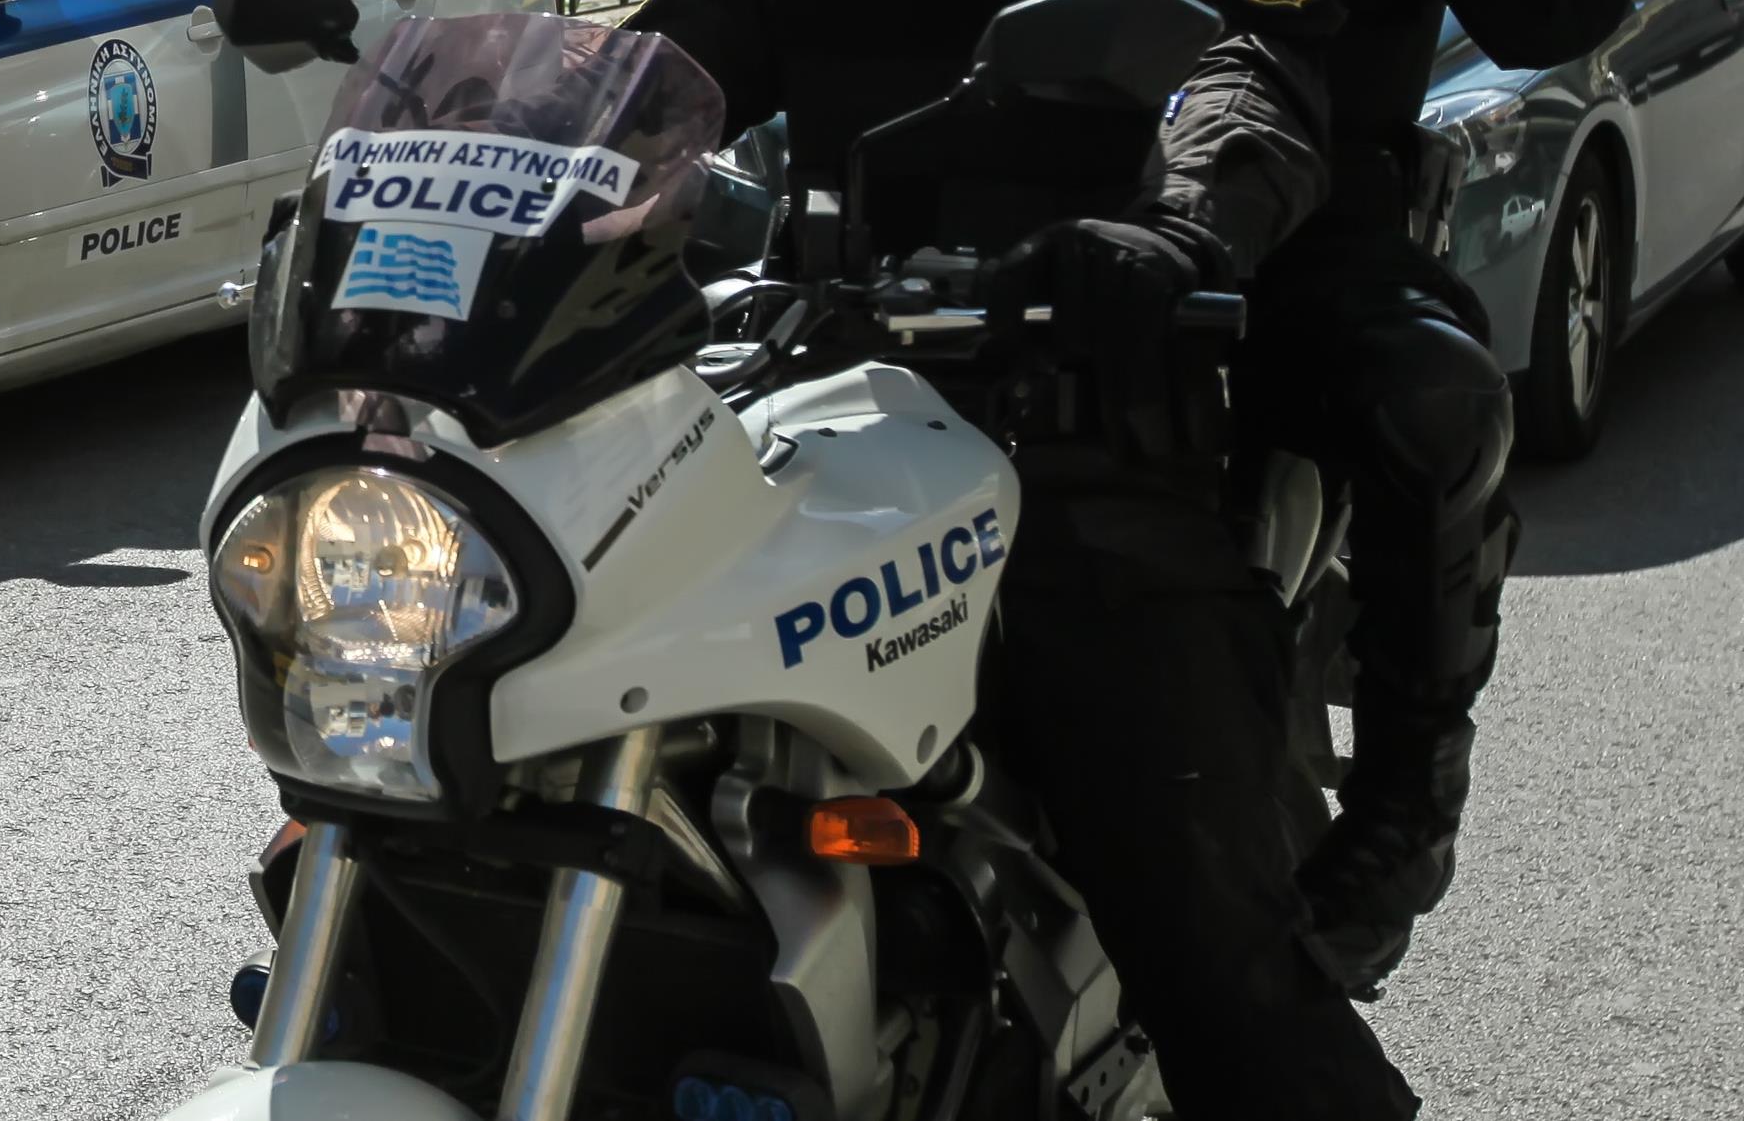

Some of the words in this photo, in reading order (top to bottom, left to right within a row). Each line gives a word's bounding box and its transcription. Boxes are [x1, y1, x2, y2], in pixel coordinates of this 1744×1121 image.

[89, 46, 111, 157] ΕΛΛΗΝΙΚΗ
[112, 42, 156, 145] ΑΣΤΥΝΟΜΙΑ
[320, 138, 447, 169] ΕΛΛΗΝΙΚΗ
[449, 142, 622, 194] ΑΣΤΥΝΟΜΙΑ
[334, 175, 556, 226] POLICE
[80, 212, 182, 261] POLICE
[627, 406, 716, 510] Versys
[773, 507, 1006, 670] POLICE
[865, 592, 969, 673] Kawasaki
